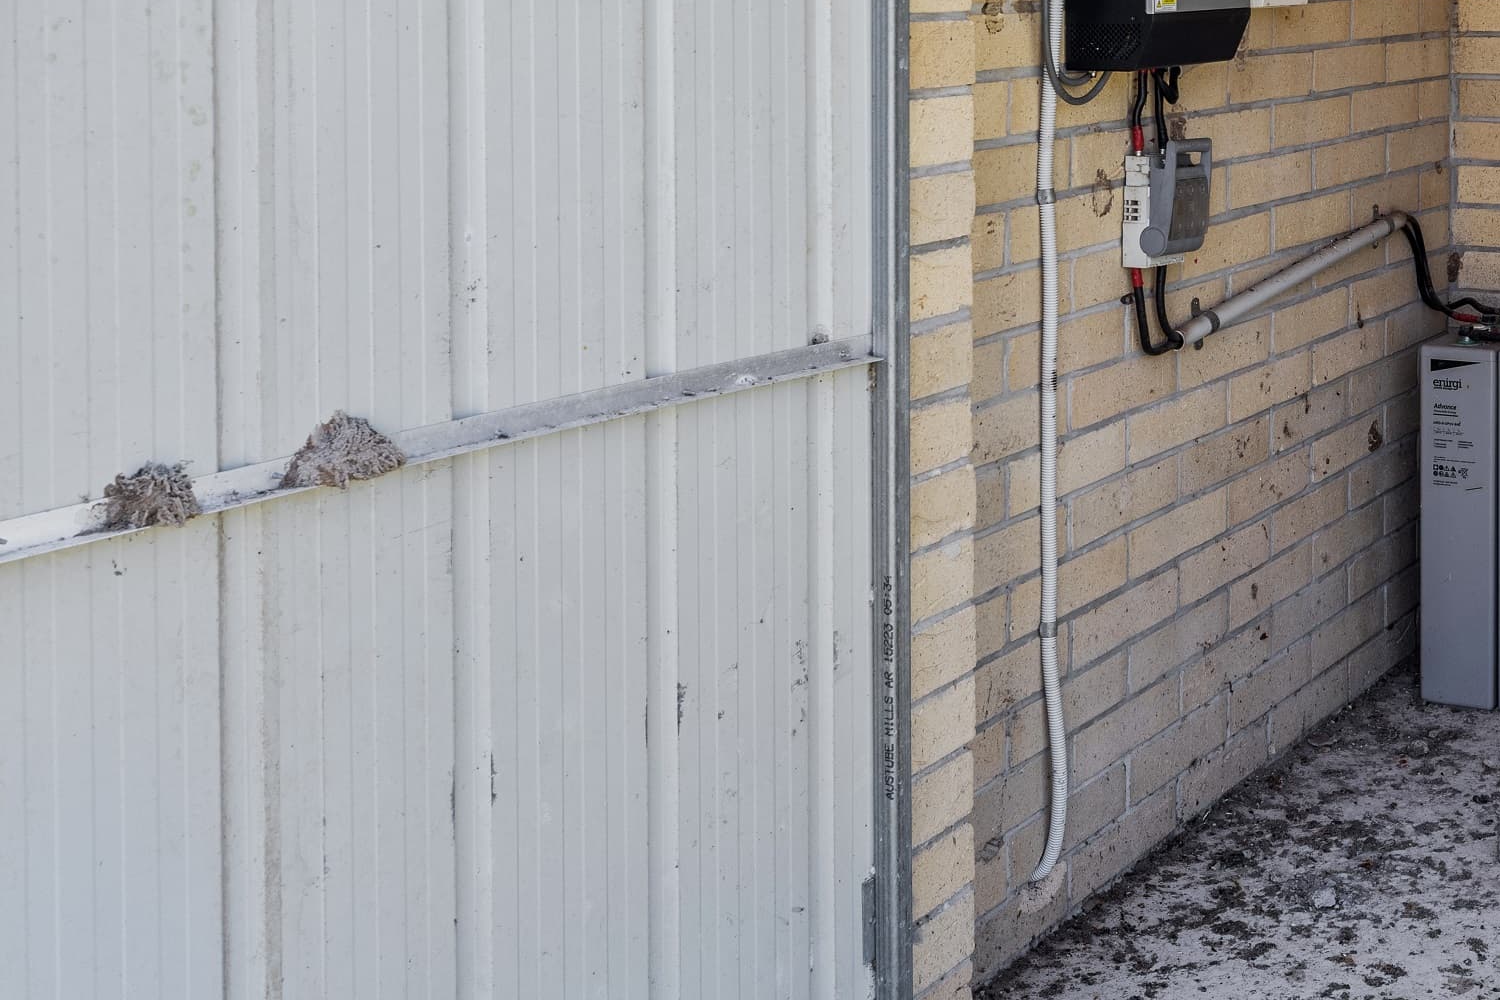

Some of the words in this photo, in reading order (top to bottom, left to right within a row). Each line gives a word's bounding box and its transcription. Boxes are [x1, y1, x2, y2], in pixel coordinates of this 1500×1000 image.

[1433, 378, 1462, 390] enirgi
[884, 672, 894, 688] AR
[884, 696, 894, 736] MILLS
[884, 743, 894, 800] AUSTUBE
